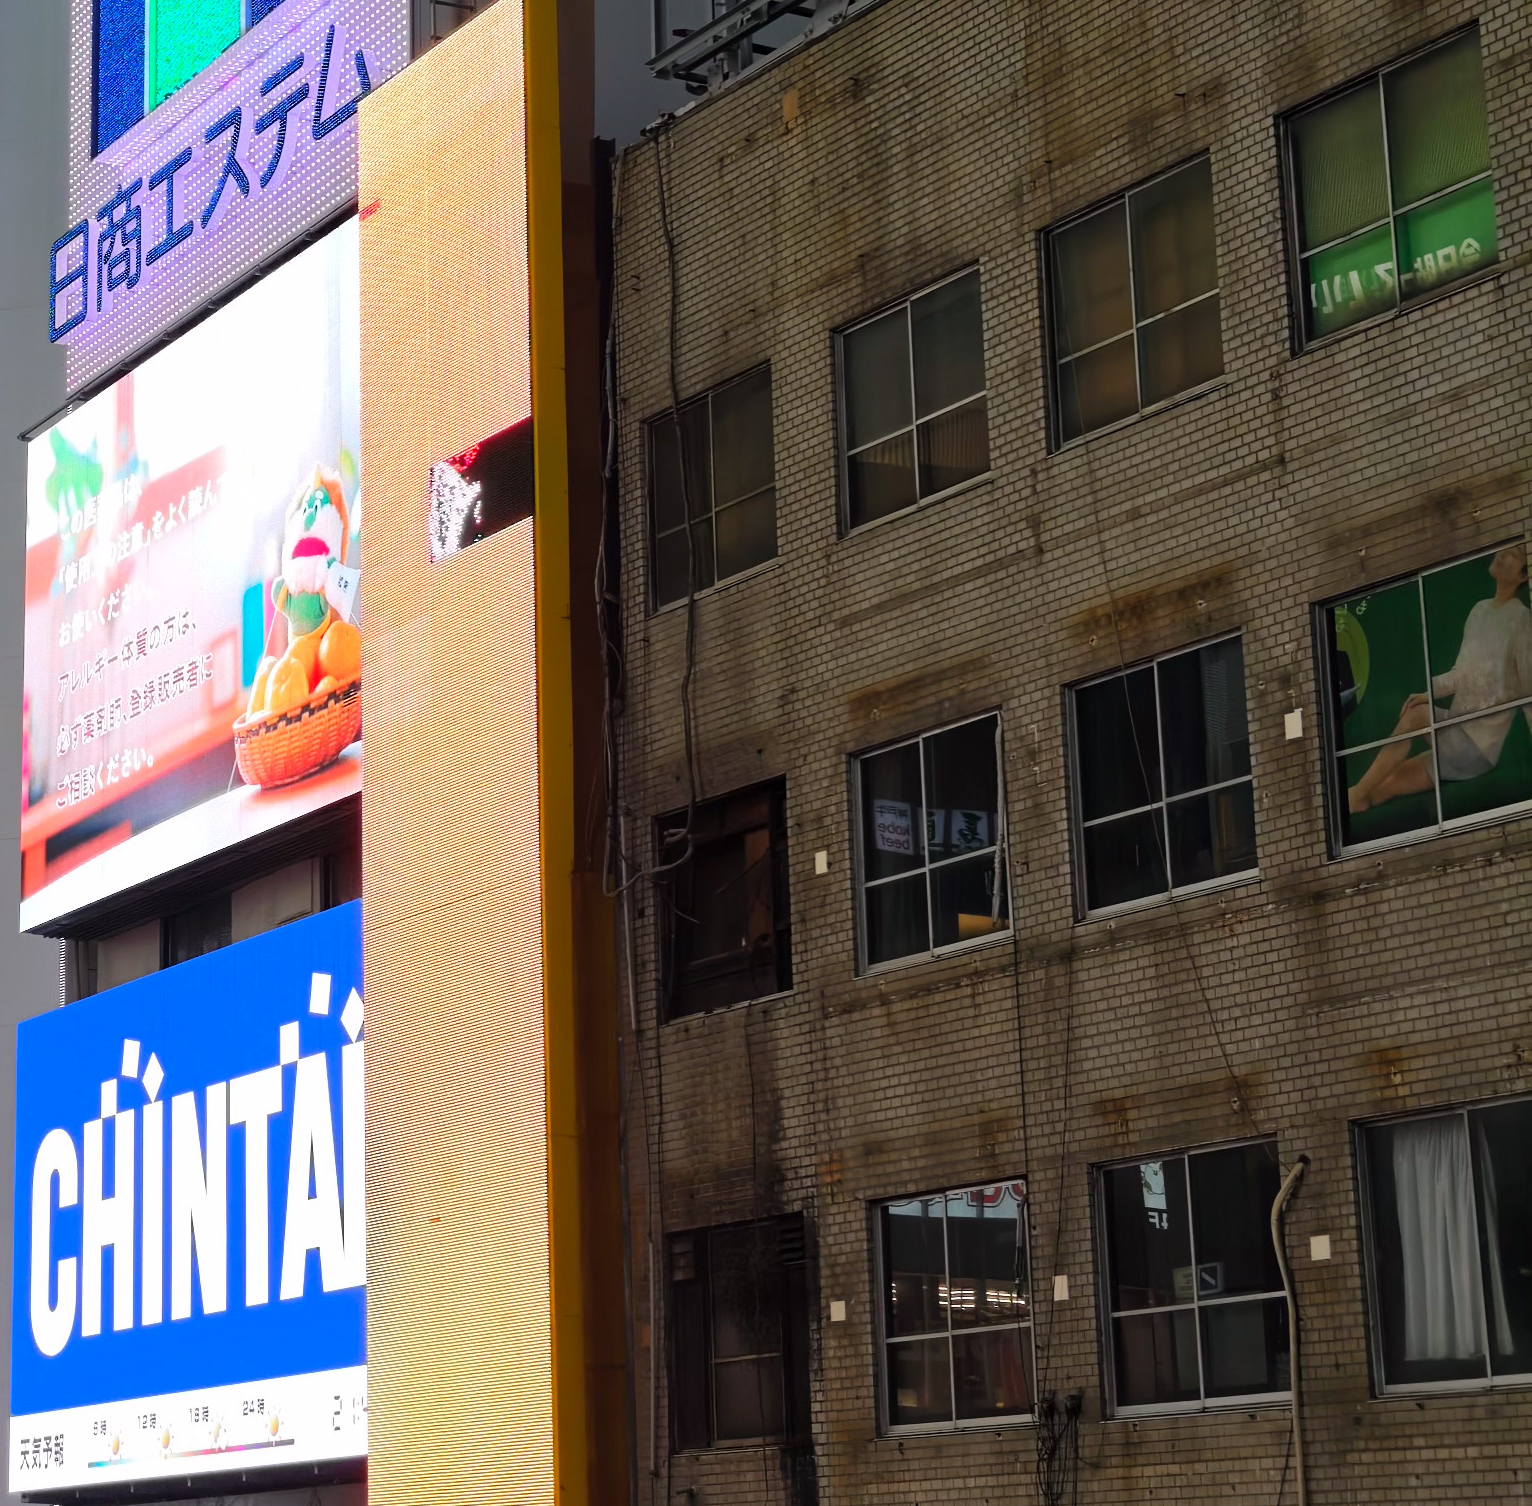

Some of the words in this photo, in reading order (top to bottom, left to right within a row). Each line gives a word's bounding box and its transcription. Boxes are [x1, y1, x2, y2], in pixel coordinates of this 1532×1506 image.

[49, 25, 371, 343] 日商エステム
[58, 608, 196, 701] アレルギー体質の方は、
[56, 654, 213, 757] 必ず薬剤師、登録販売者に
[56, 747, 154, 809] ご相談ください。
